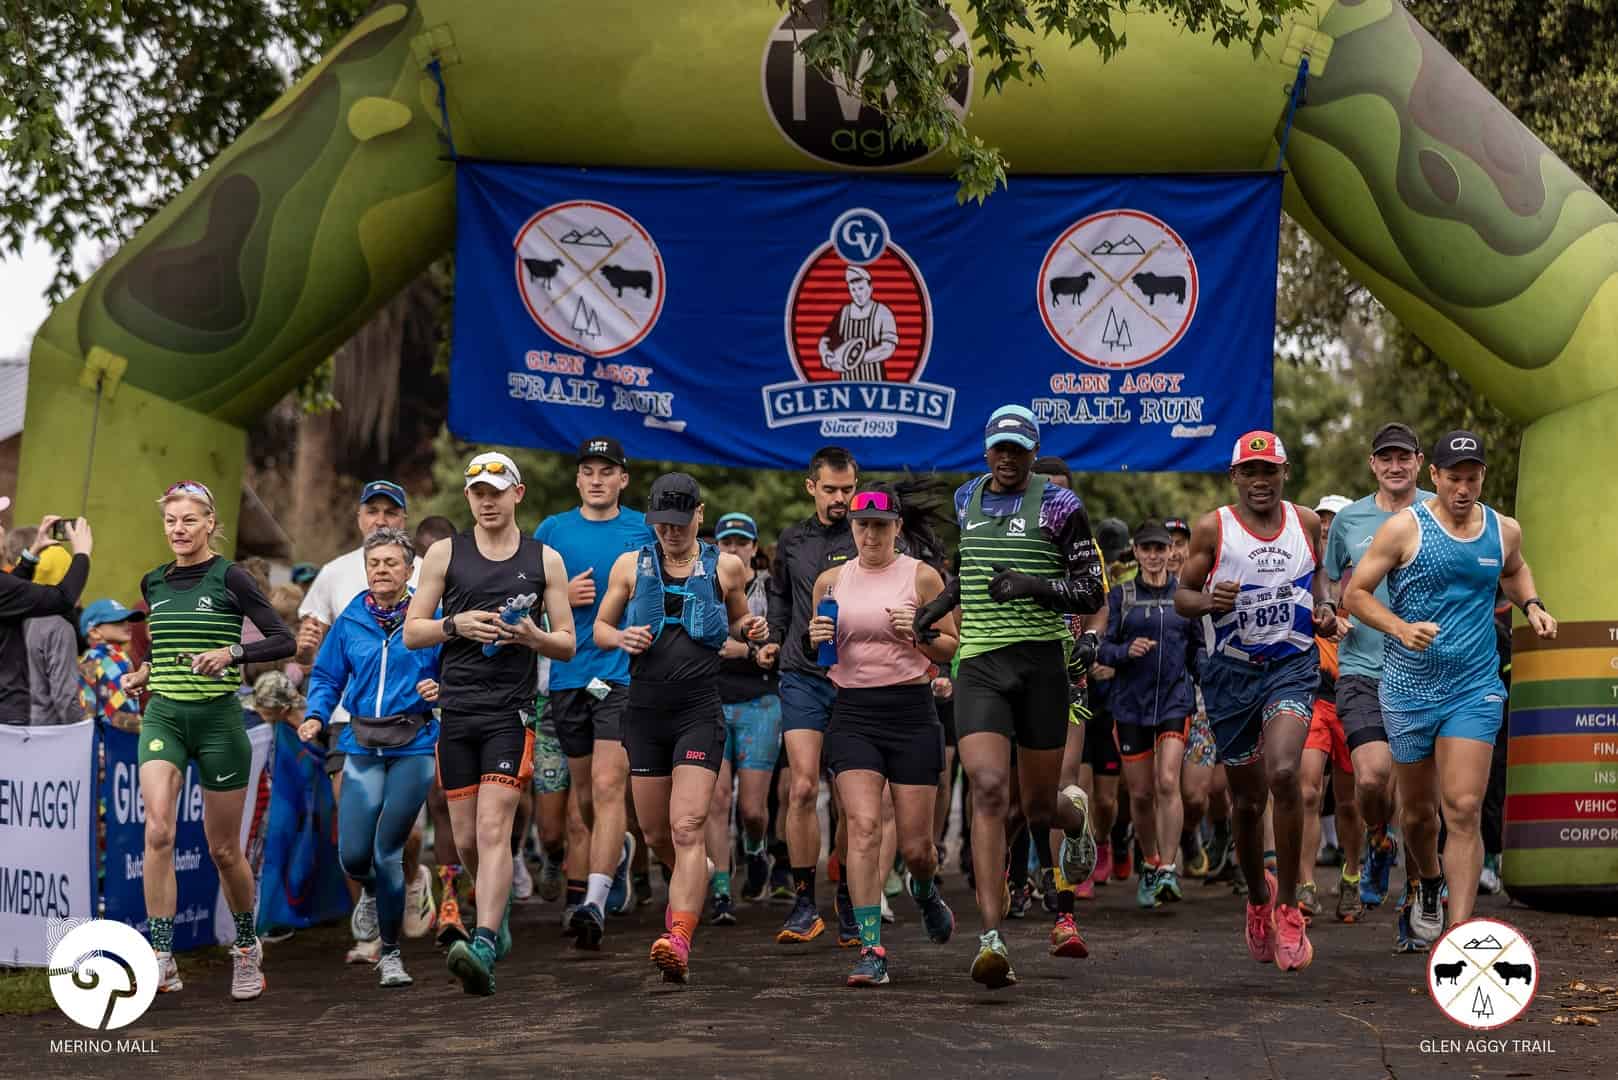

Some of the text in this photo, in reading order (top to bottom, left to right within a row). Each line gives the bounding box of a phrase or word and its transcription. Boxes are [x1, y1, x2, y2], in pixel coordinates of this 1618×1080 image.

[842, 220, 879, 258] GV
[526, 351, 653, 387] GLEN AGGY
[1049, 373, 1185, 393] GLEN AGGY
[509, 373, 674, 418] TRAIL RUN
[775, 388, 943, 416] GLEN VLEIS
[1032, 397, 1204, 425] TRAIL RUN
[823, 420, 895, 433] Since 1993
[1239, 603, 1290, 629] P 823
[28, 780, 81, 830] AGGY
[1575, 799, 1617, 812] VEHIC
